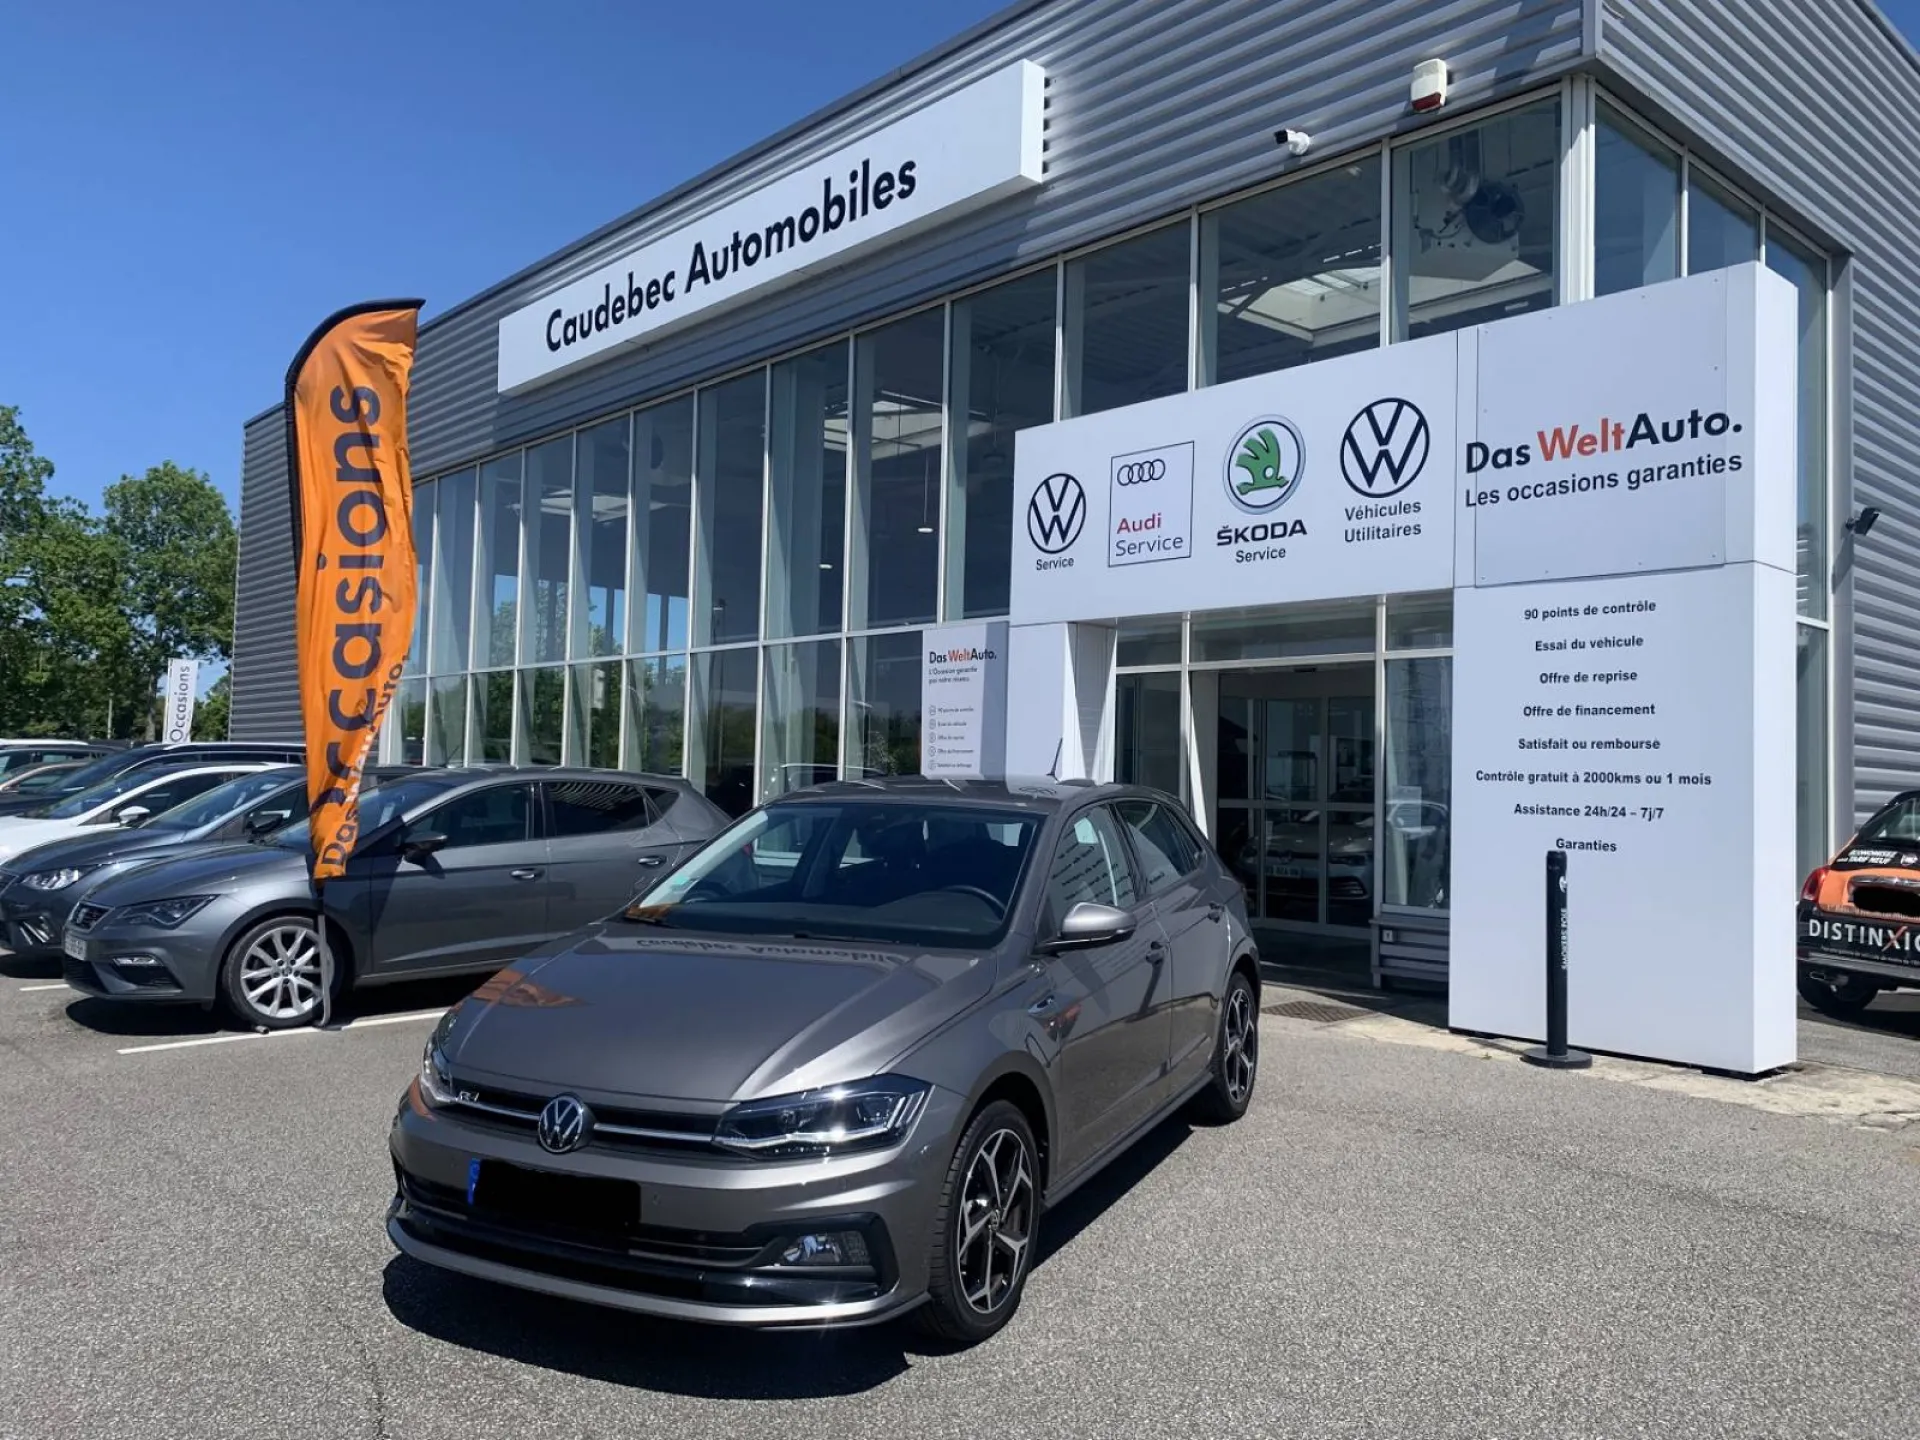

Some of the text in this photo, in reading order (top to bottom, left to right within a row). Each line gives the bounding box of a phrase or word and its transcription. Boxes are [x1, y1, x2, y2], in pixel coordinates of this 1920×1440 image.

[545, 158, 917, 352] Caudebec Automobiles
[1467, 409, 1742, 473] Das WeltAuto.
[1466, 454, 1742, 507] Les occasions garanties
[1345, 497, 1421, 521] Véhicules
[1117, 513, 1161, 534] Audi
[1217, 520, 1307, 546] ŠKODA
[1345, 524, 1421, 542] Utilitaires
[1115, 533, 1184, 557] Service
[1036, 553, 1074, 570] Service
[1236, 547, 1285, 563] Service
[1524, 599, 1657, 622] 90 points de contrôle
[1535, 639, 1567, 652] Essai
[1570, 638, 1586, 650] du
[929, 648, 997, 663] Das WeltAuto.
[1539, 669, 1638, 685] Offre de reprise
[170, 666, 190, 742] Occasions
[1523, 703, 1656, 717] Offre de financement
[1518, 737, 1569, 750] Satisfait
[1571, 740, 1588, 750] ou
[1475, 769, 1712, 786] Contrôle gratuit à 2000kms ou 1 mois
[1513, 803, 1581, 817] Assistance
[1584, 805, 1627, 818] 24h/24
[1640, 806, 1665, 822] 7j/7
[1556, 838, 1618, 852] Garanties
